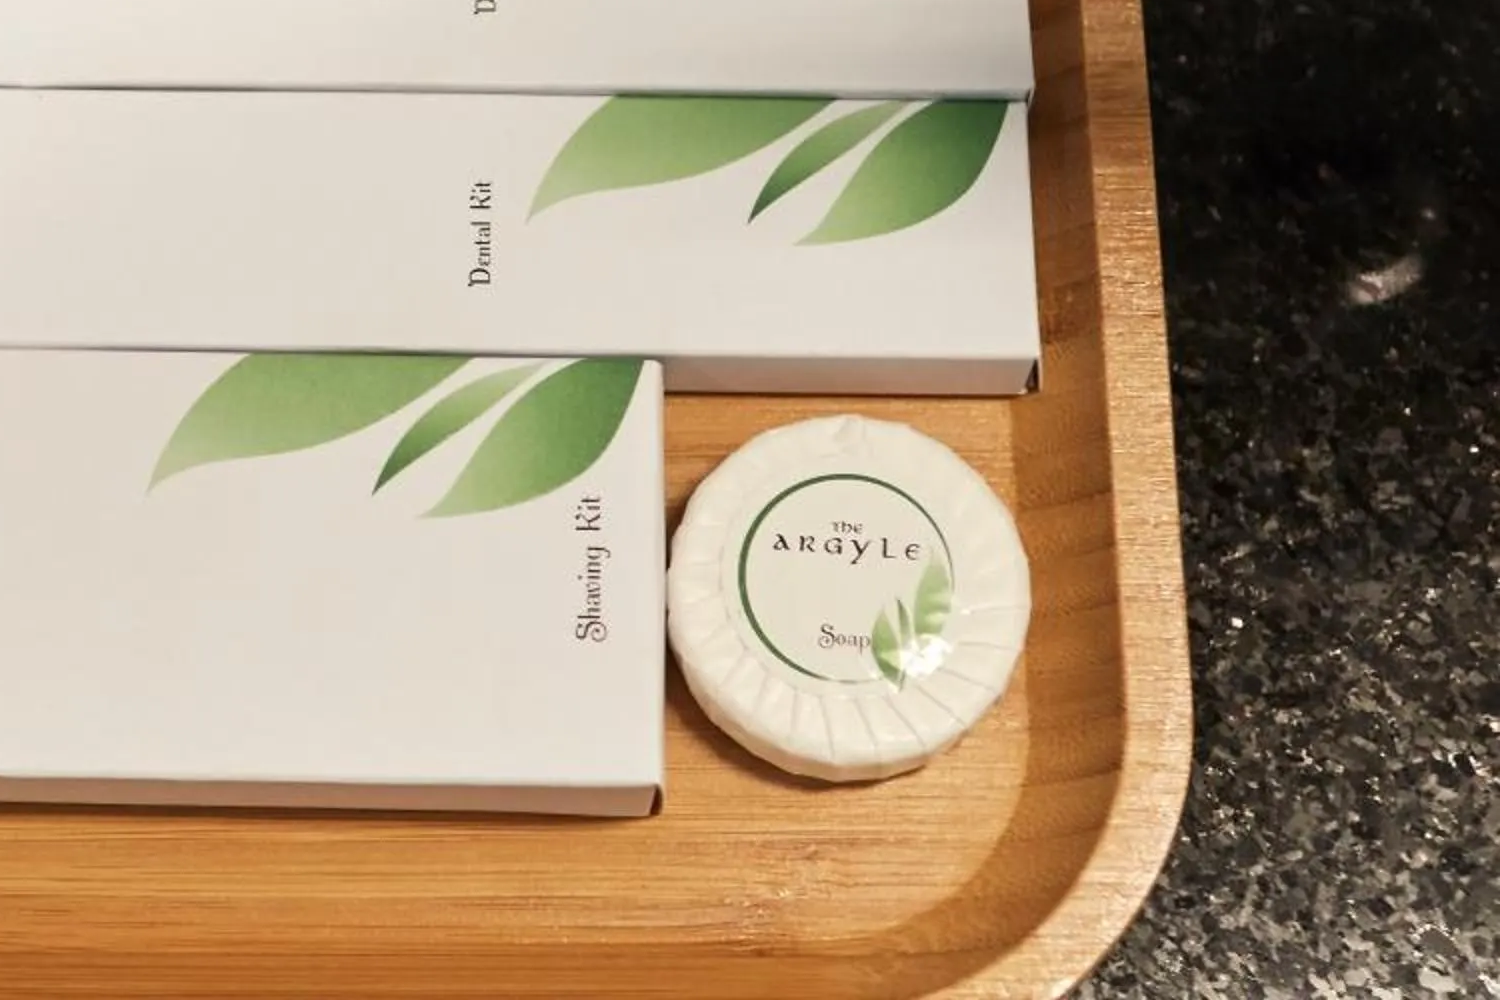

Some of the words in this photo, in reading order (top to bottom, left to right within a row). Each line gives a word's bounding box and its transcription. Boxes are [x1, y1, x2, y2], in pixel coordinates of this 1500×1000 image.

[469, 182, 492, 210] Kit
[467, 221, 491, 288] Dental
[574, 497, 601, 532] Kit
[772, 533, 922, 565] ARGYLE
[575, 546, 611, 643] Shaving
[818, 623, 871, 653] Soap
